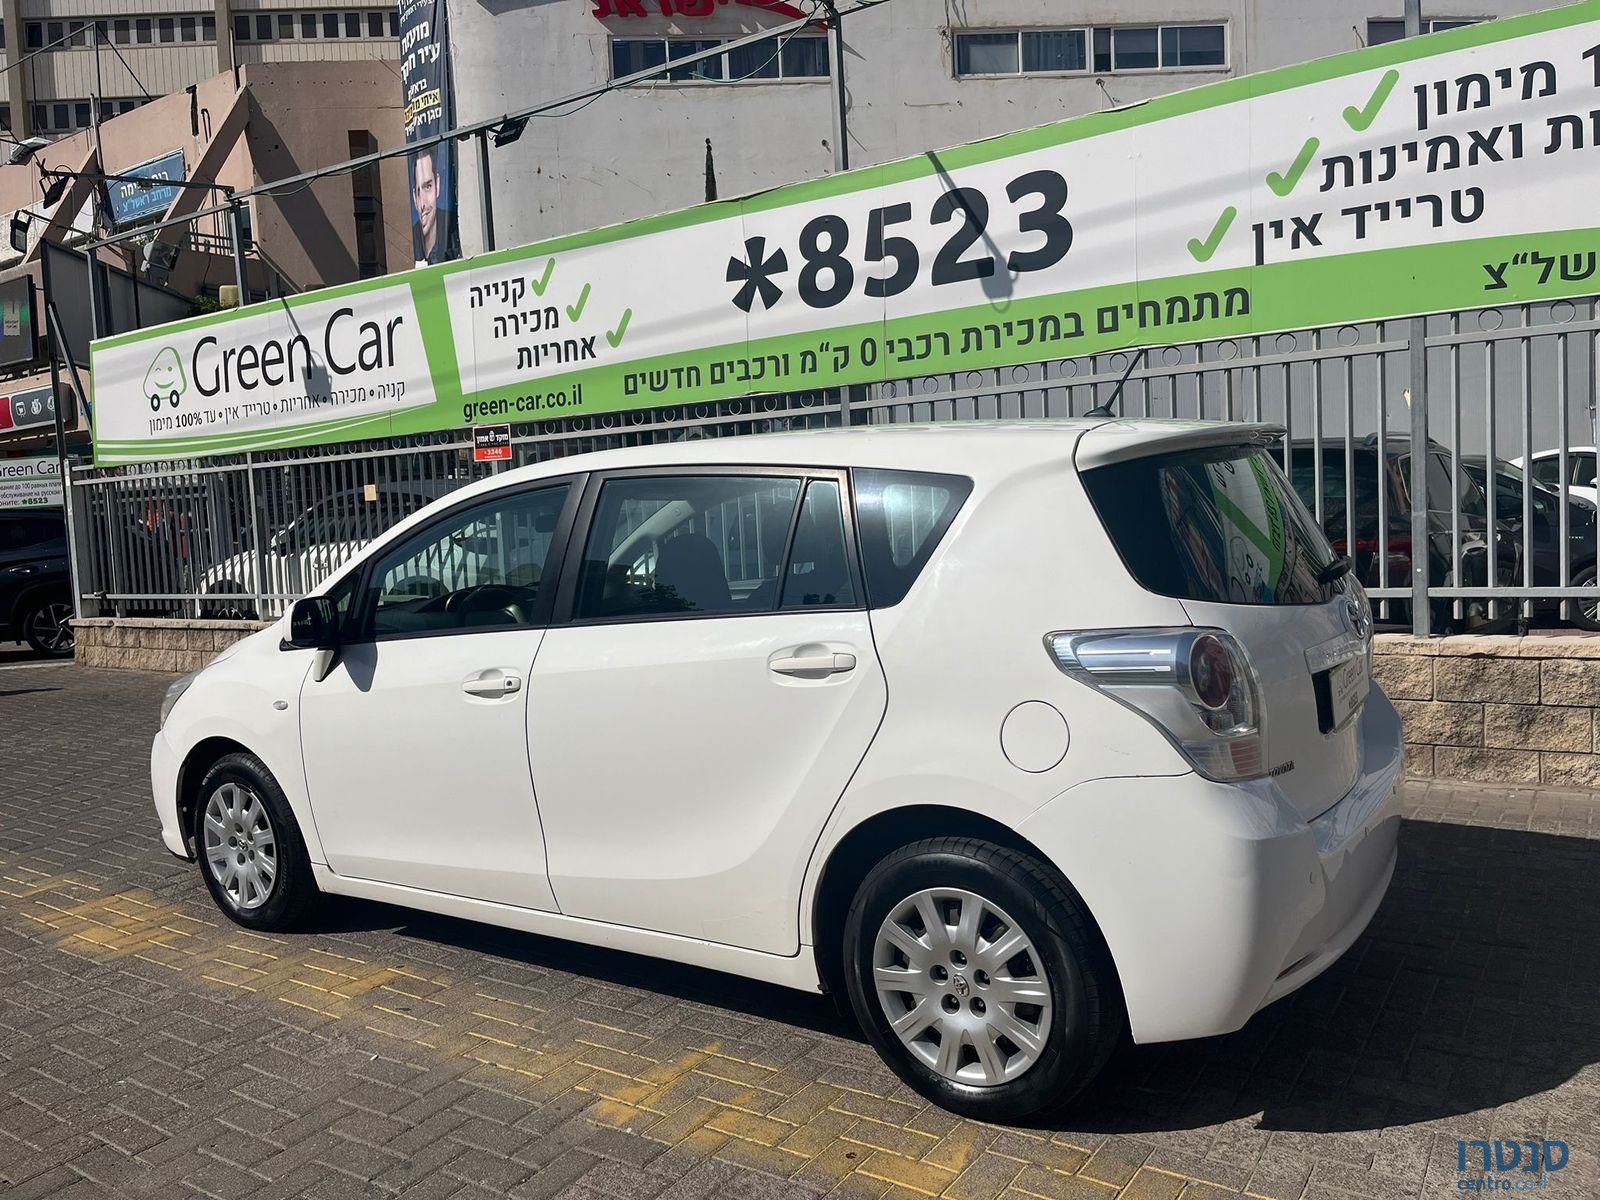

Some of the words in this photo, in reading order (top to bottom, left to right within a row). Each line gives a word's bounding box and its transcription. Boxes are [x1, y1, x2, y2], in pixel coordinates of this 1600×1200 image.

[417, 42, 441, 65] עיר
[1413, 60, 1557, 131] מימון
[427, 107, 442, 125] סגן
[1319, 123, 1523, 193] ואמינות
[150, 186, 172, 202] מרחב
[1341, 186, 1485, 240] טרייד
[1251, 212, 1324, 266] אין
[470, 276, 526, 308] קנייה
[493, 306, 560, 338] מכירה
[1096, 287, 1251, 334] מתמחים
[886, 331, 950, 362] רכבי
[960, 310, 1085, 353] במכירת
[192, 334, 313, 397] Green
[324, 307, 403, 375] Car
[517, 335, 597, 370] אחריות
[860, 337, 877, 367] 0
[623, 365, 701, 395] חדשים
[710, 353, 790, 385] ורכבים
[280, 393, 320, 413] אחריות
[330, 387, 367, 406] מכירה
[377, 381, 405, 401] קניה
[463, 383, 583, 423] green-car.co.il
[175, 411, 203, 428] 100%
[203, 409, 216, 423] עד
[224, 405, 240, 425] אין
[242, 401, 271, 418] טרייד
[149, 416, 173, 436] מימון
[37, 460, 60, 475] Car
